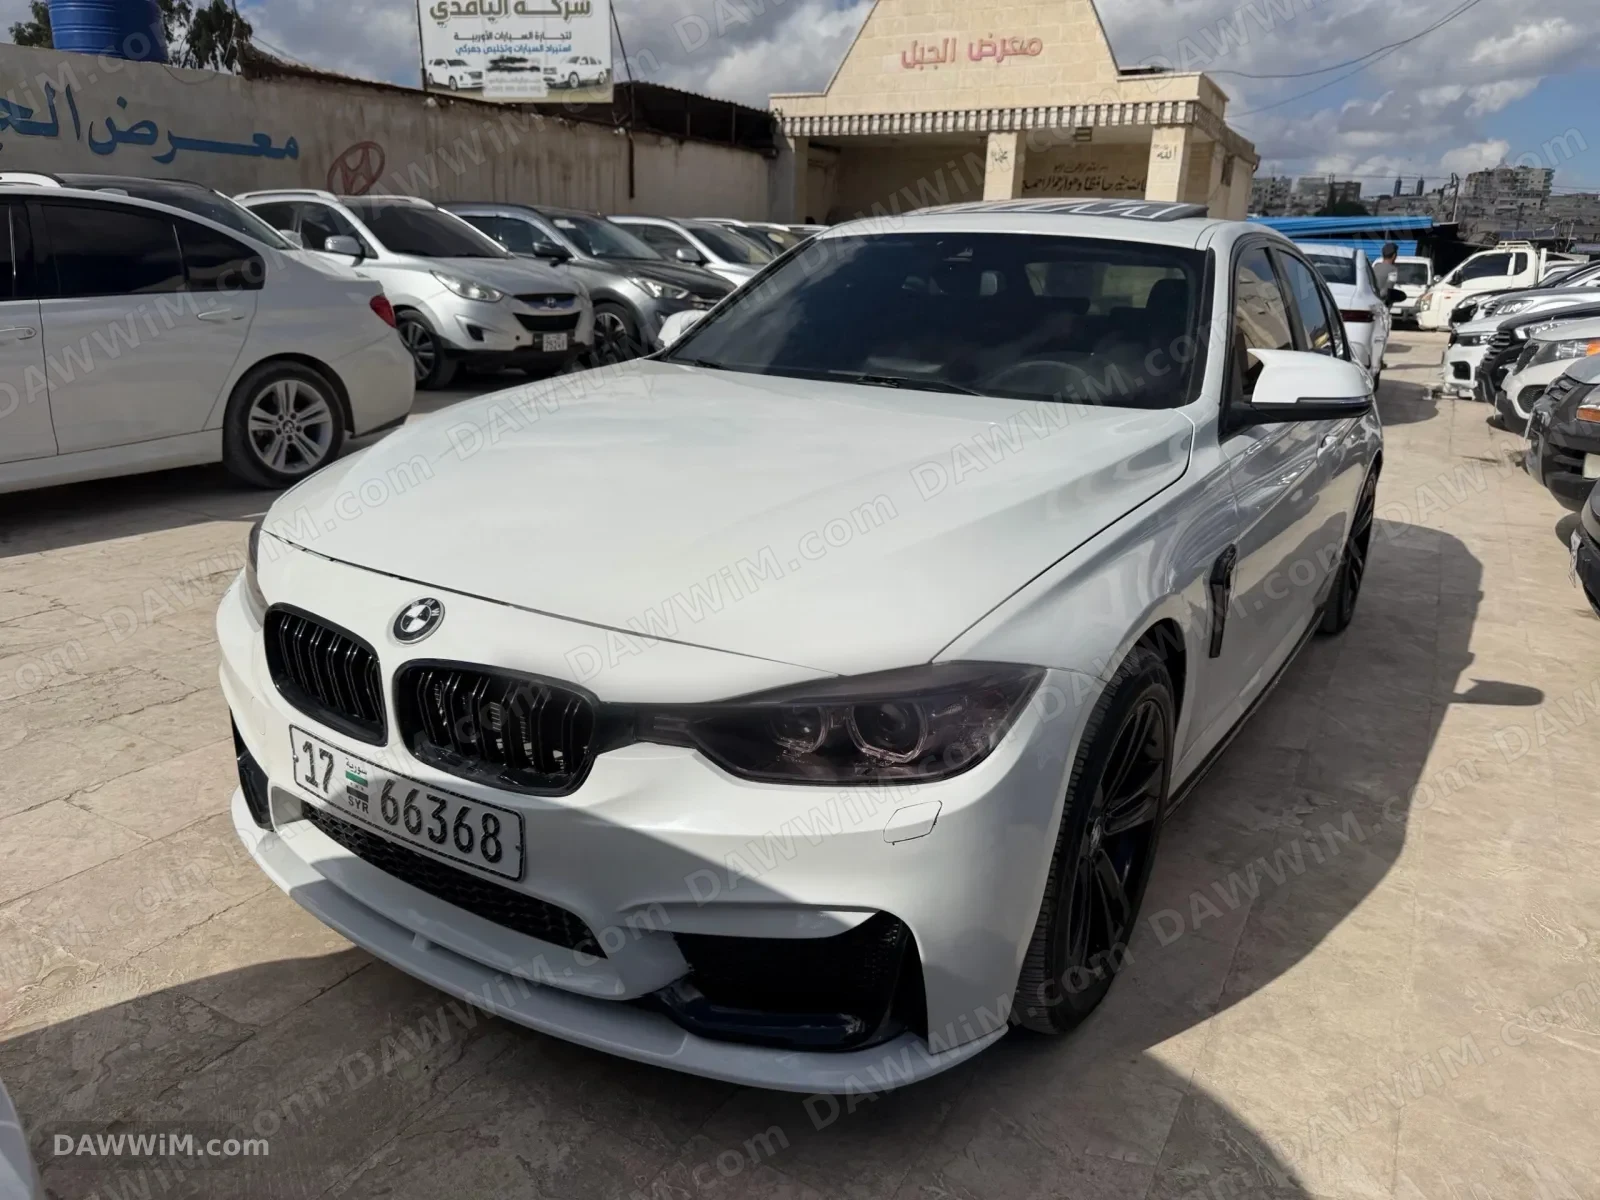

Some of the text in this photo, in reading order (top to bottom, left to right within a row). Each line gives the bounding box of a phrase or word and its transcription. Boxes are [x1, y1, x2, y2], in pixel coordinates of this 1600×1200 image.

[494, 31, 533, 42] السيارات
[513, 43, 543, 54] السيارات
[901, 33, 1043, 70] معرض الجبل
[88, 95, 299, 164] معرض
[303, 740, 334, 793] 17
[345, 757, 367, 776] سورية
[347, 794, 369, 814] SYR
[381, 778, 501, 863] 66368
